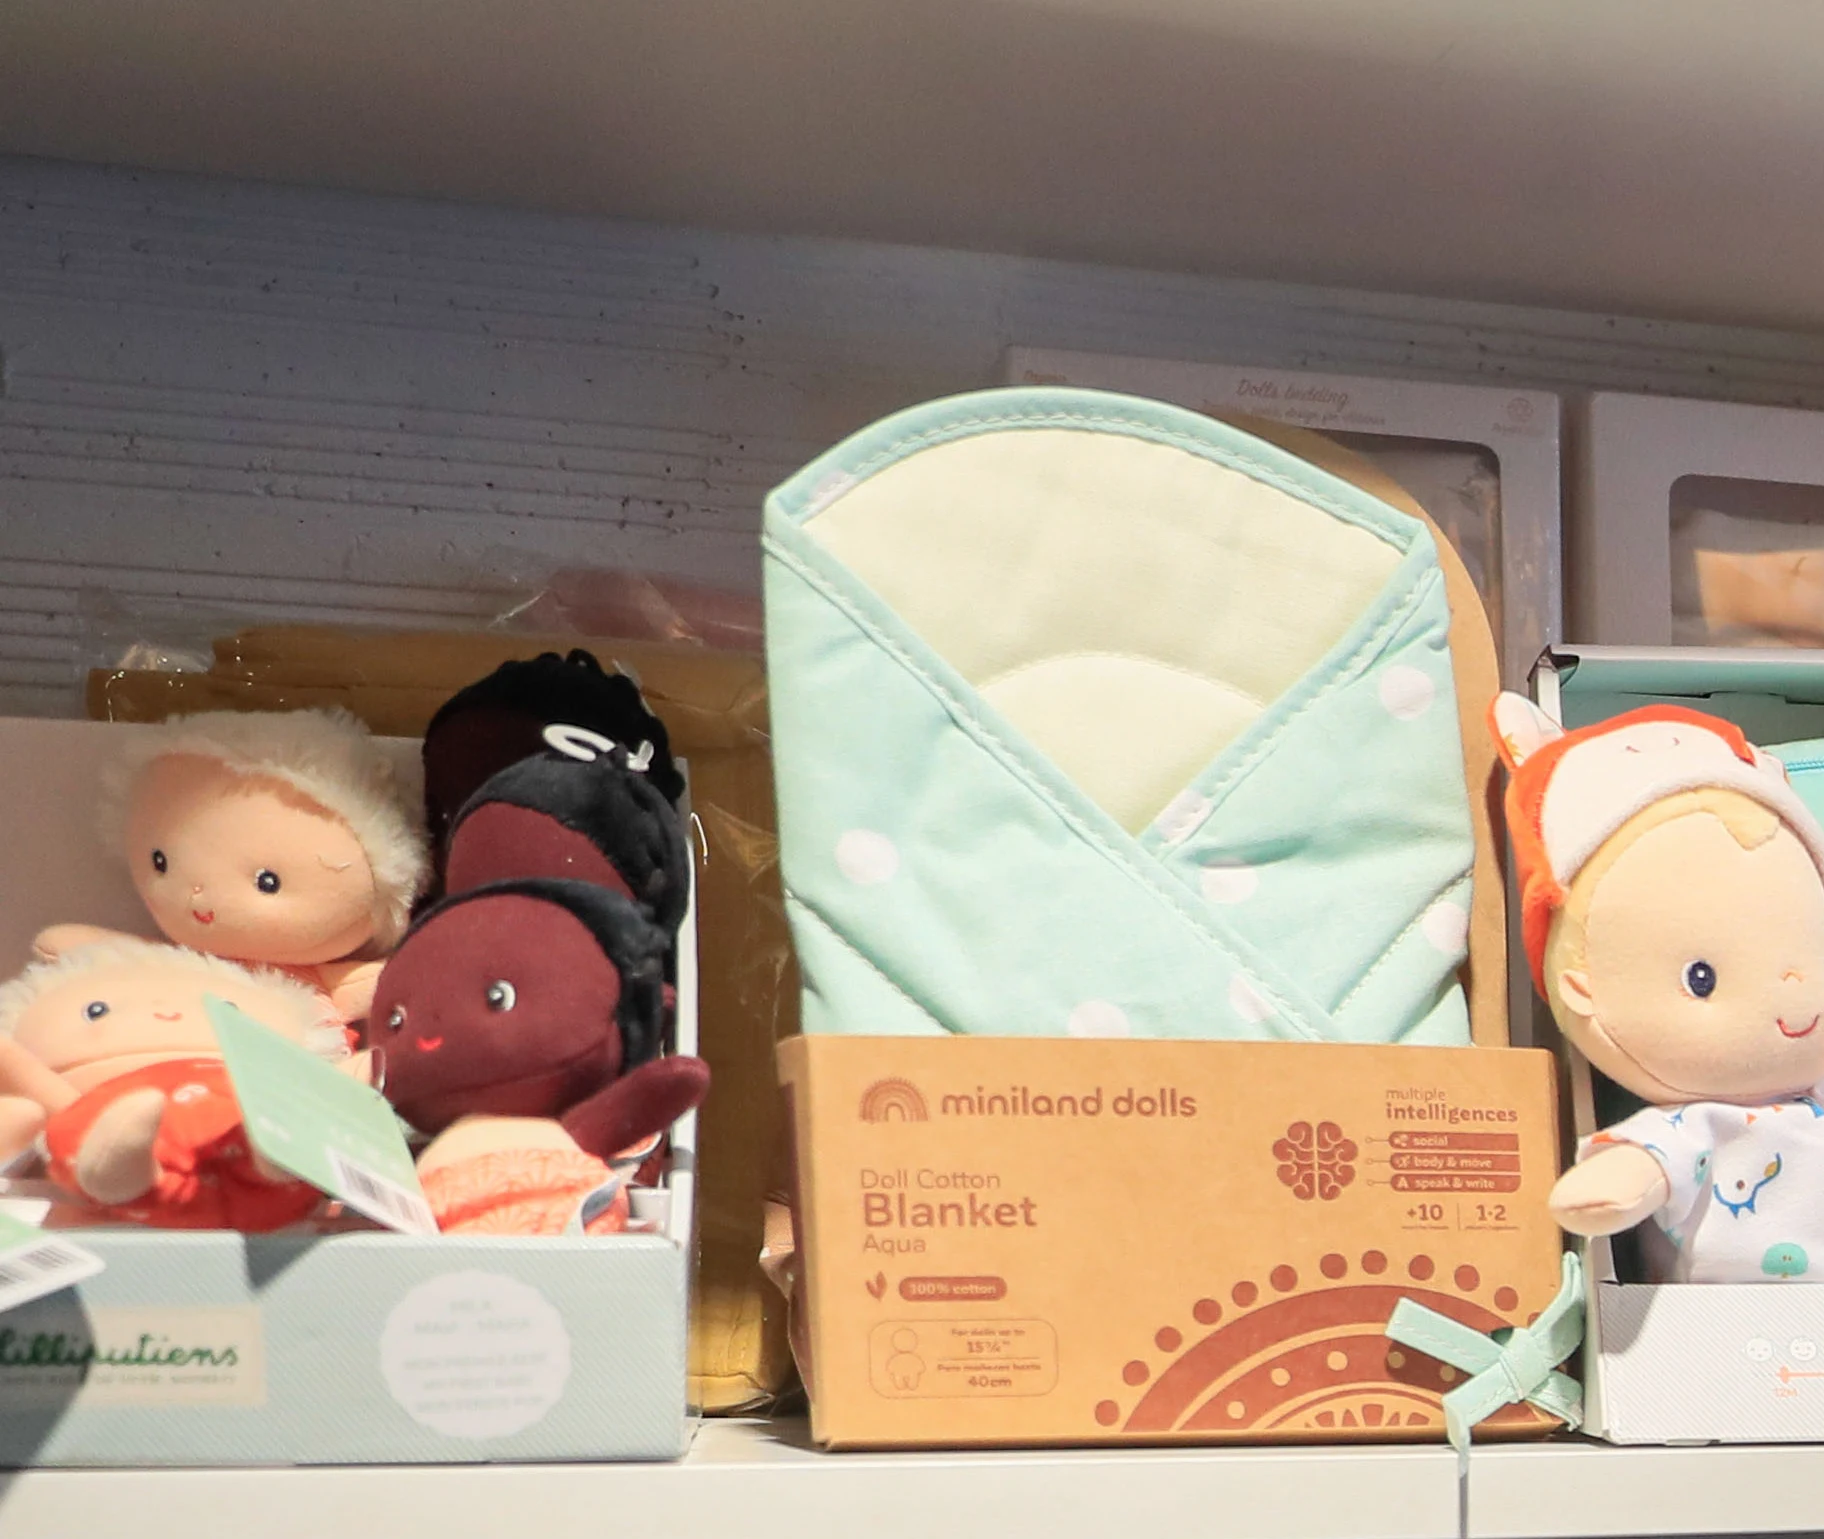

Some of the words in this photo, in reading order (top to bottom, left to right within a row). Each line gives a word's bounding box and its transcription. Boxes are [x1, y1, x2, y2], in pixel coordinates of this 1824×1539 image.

[940, 1086, 1103, 1118] miniland
[1112, 1086, 1198, 1119] dolls
[1385, 1086, 1446, 1103] multiple
[1385, 1102, 1519, 1125] intelligences
[1412, 1136, 1449, 1146] social
[1414, 1156, 1444, 1169] body
[859, 1168, 908, 1190] Doll
[916, 1168, 1001, 1190] Cotton
[1465, 1178, 1496, 1189] write
[862, 1192, 1039, 1228] Blanket
[1406, 1203, 1444, 1222] +10
[861, 1233, 927, 1257] Aqua
[952, 1282, 997, 1295] cotton
